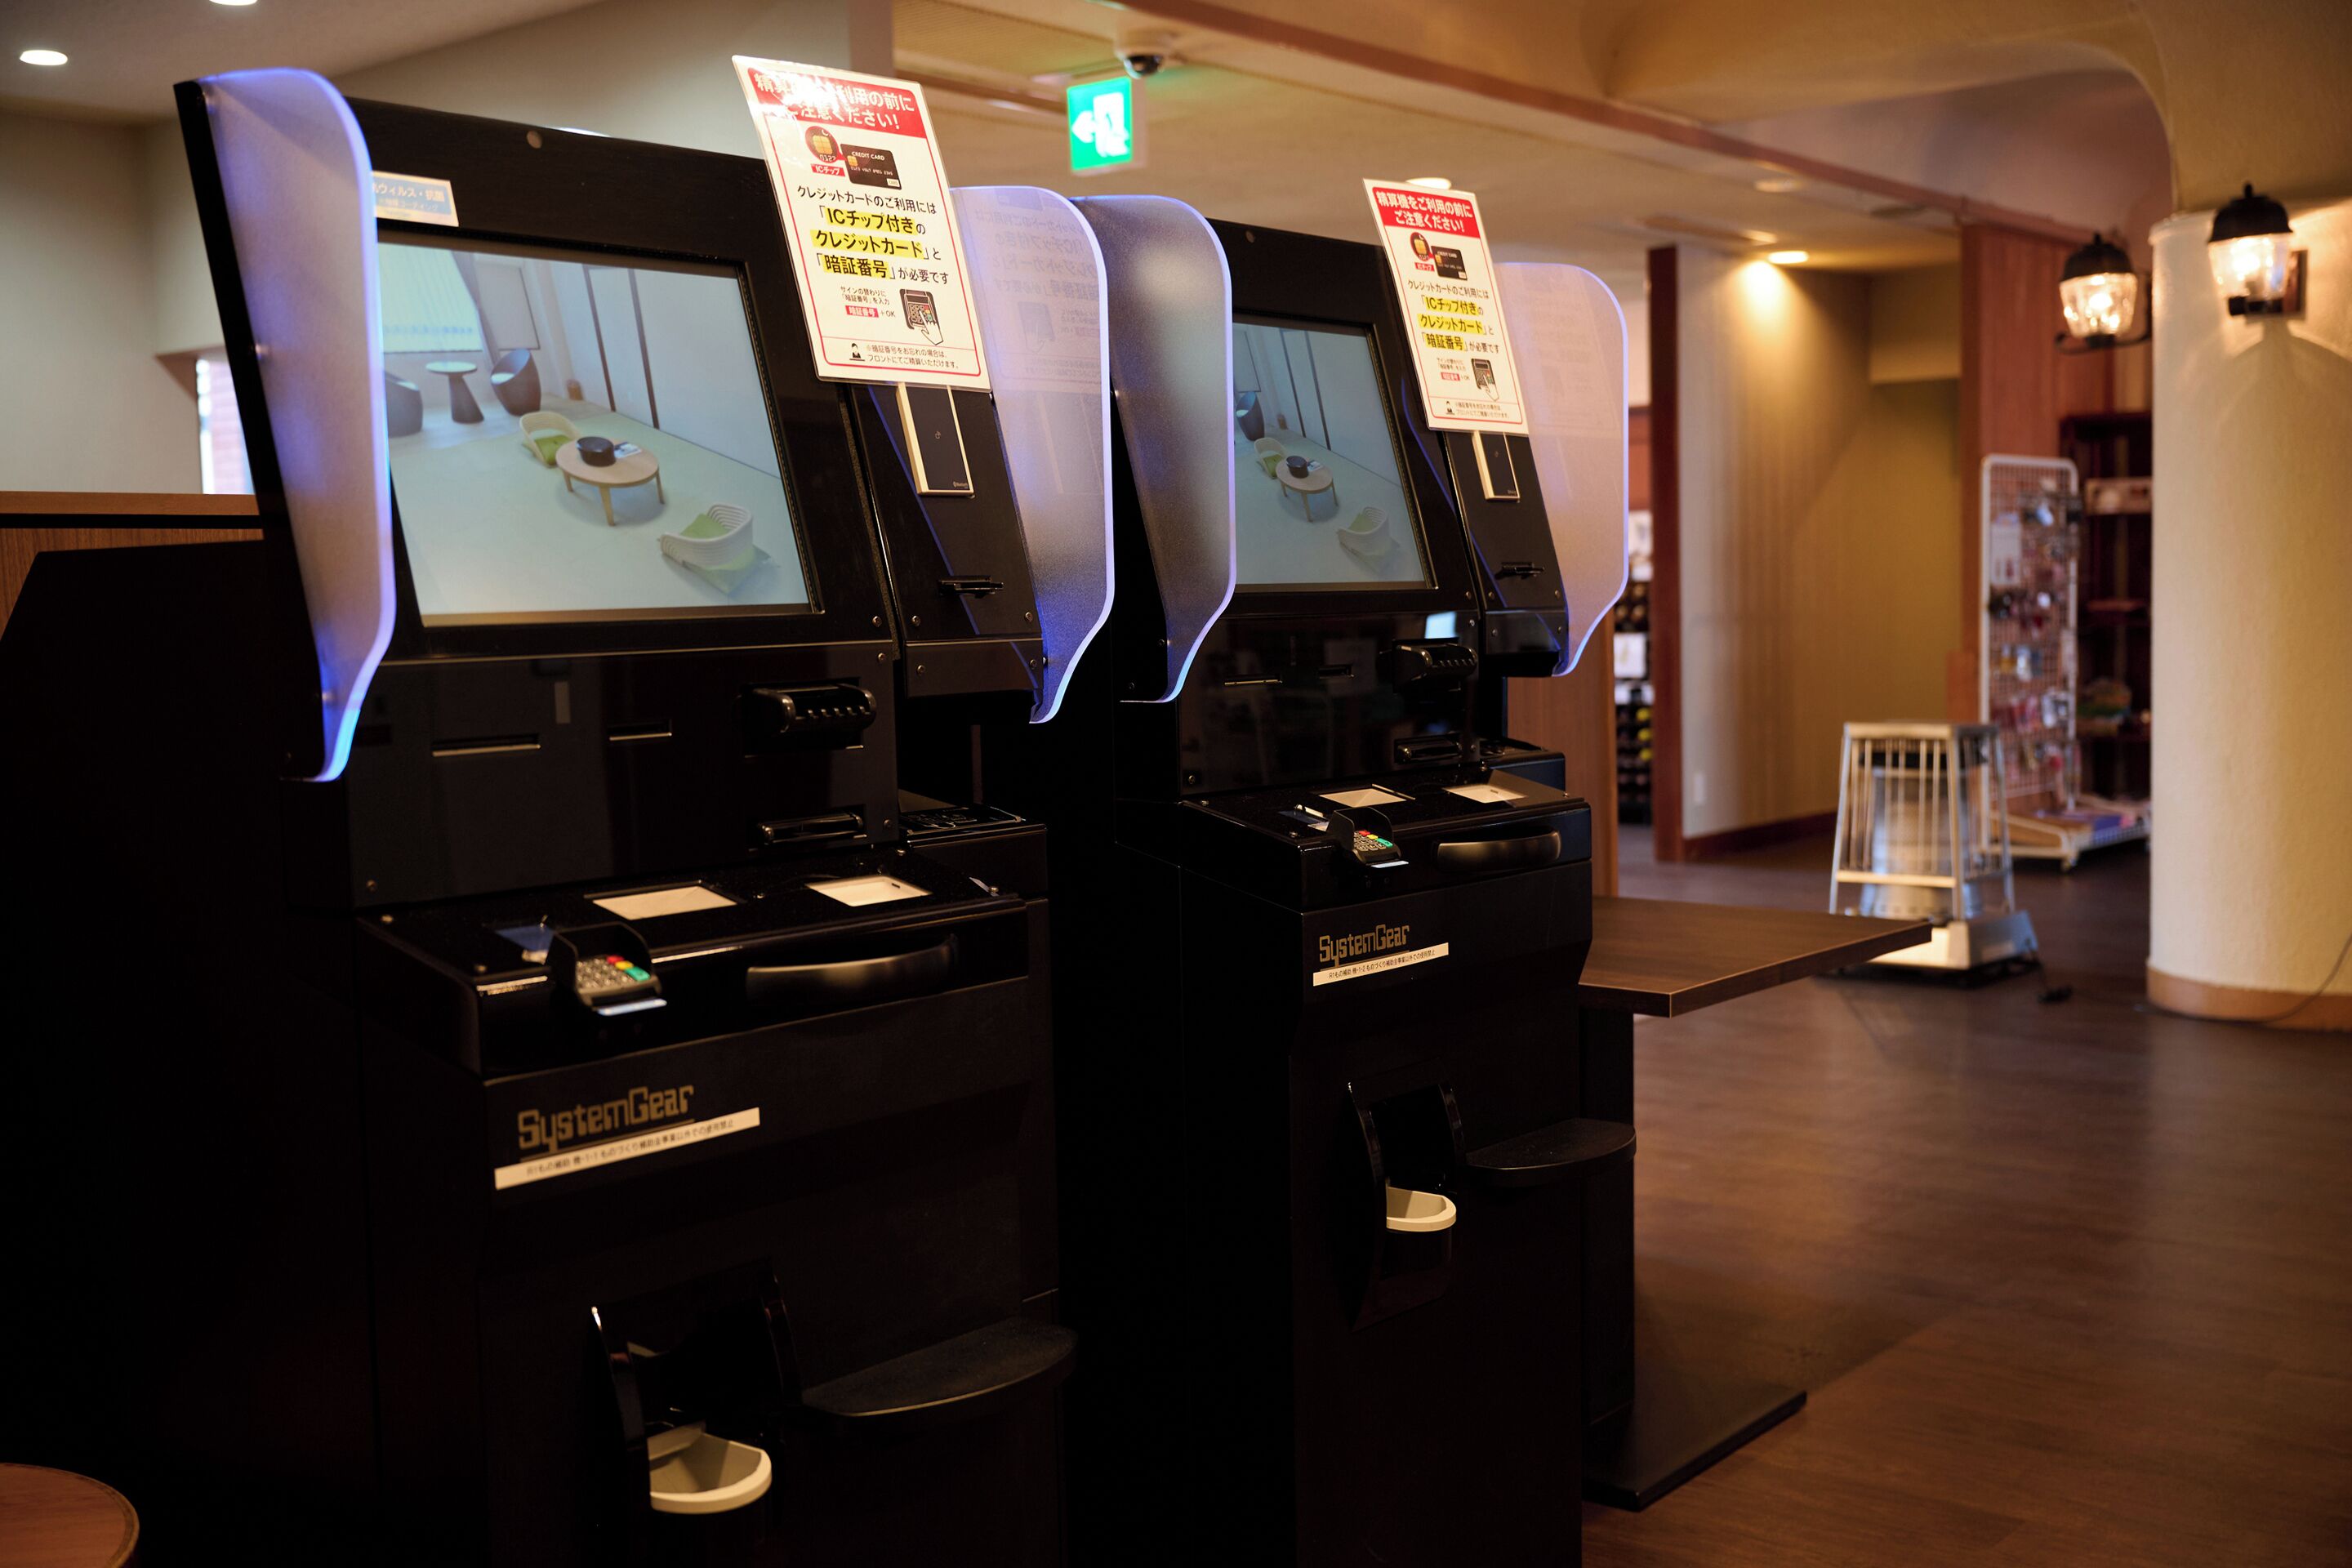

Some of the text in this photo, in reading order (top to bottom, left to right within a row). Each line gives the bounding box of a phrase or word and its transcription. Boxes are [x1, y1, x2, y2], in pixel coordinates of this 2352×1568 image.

[851, 150, 886, 162] CREDIT CARD
[815, 166, 840, 176] ICチップ
[797, 185, 938, 215] クレジットカードのご利用には
[1375, 190, 1473, 218] 精算機をご利用の前に
[819, 205, 926, 235] 「ICチップ付きの
[1394, 210, 1465, 233] ご注意ください!
[816, 229, 942, 261] クレジットカード」と
[816, 252, 949, 284] 「暗証番号」が必要です
[1407, 280, 1490, 299] クレジットカードのご利用には
[1421, 295, 1484, 315] 「ICチップ付きの
[1420, 314, 1494, 336] クレジットカード」と
[1421, 332, 1499, 354] 「暗証番号」が必要です
[1319, 924, 1410, 967] SystemGear
[518, 1085, 694, 1153] SystemGear
